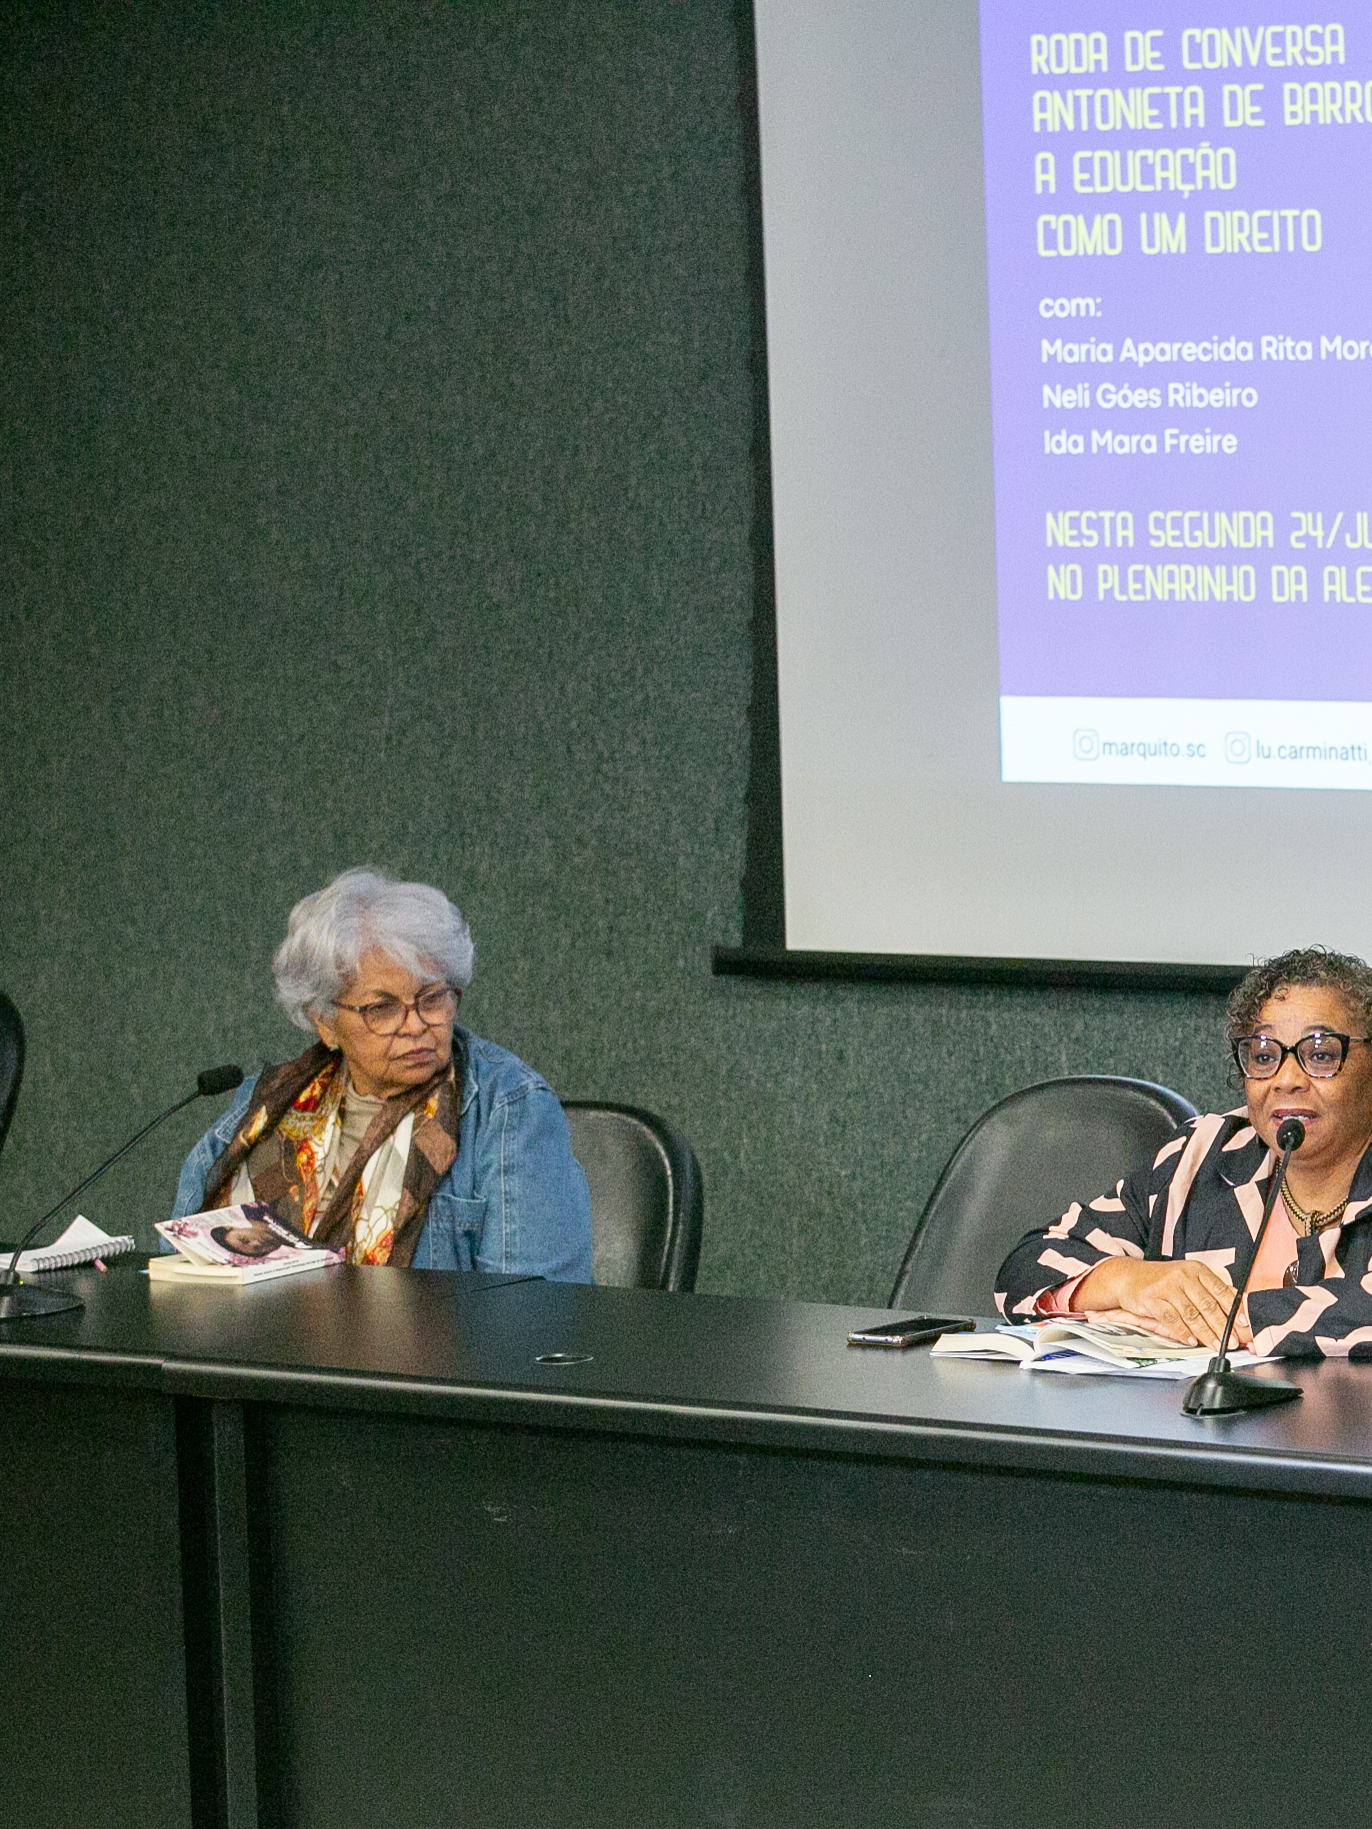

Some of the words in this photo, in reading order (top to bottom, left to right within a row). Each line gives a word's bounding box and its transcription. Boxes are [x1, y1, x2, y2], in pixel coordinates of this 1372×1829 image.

[1031, 32, 1108, 74] RODA
[1124, 30, 1165, 71] DE
[1182, 23, 1345, 69] CONVERSA
[1033, 85, 1204, 132] ANTONIETA
[1223, 84, 1265, 127] DE
[1035, 152, 1055, 194] A
[1073, 142, 1236, 198] EDUCAÇÃO
[1037, 213, 1122, 256] COMO
[1141, 212, 1186, 254] UM
[1205, 209, 1322, 253] DIREITO
[1039, 297, 1102, 318] com:
[1042, 337, 1113, 363] Maria
[1120, 336, 1253, 367] Aparecida
[1261, 335, 1312, 360] Rita
[1043, 383, 1089, 408] Neli
[1096, 383, 1161, 408] Góes
[1168, 382, 1258, 407] Ribeiro
[1044, 429, 1084, 454] Ida
[1092, 430, 1157, 454] Mara
[1165, 428, 1237, 454] Freire
[1047, 511, 1133, 547] NESTA
[1149, 511, 1273, 548] SEGUNDA
[1048, 564, 1082, 600] NO
[1098, 565, 1255, 601] PLENARINHO
[1272, 566, 1307, 602] DA
[1102, 738, 1206, 760] marquito.sc
